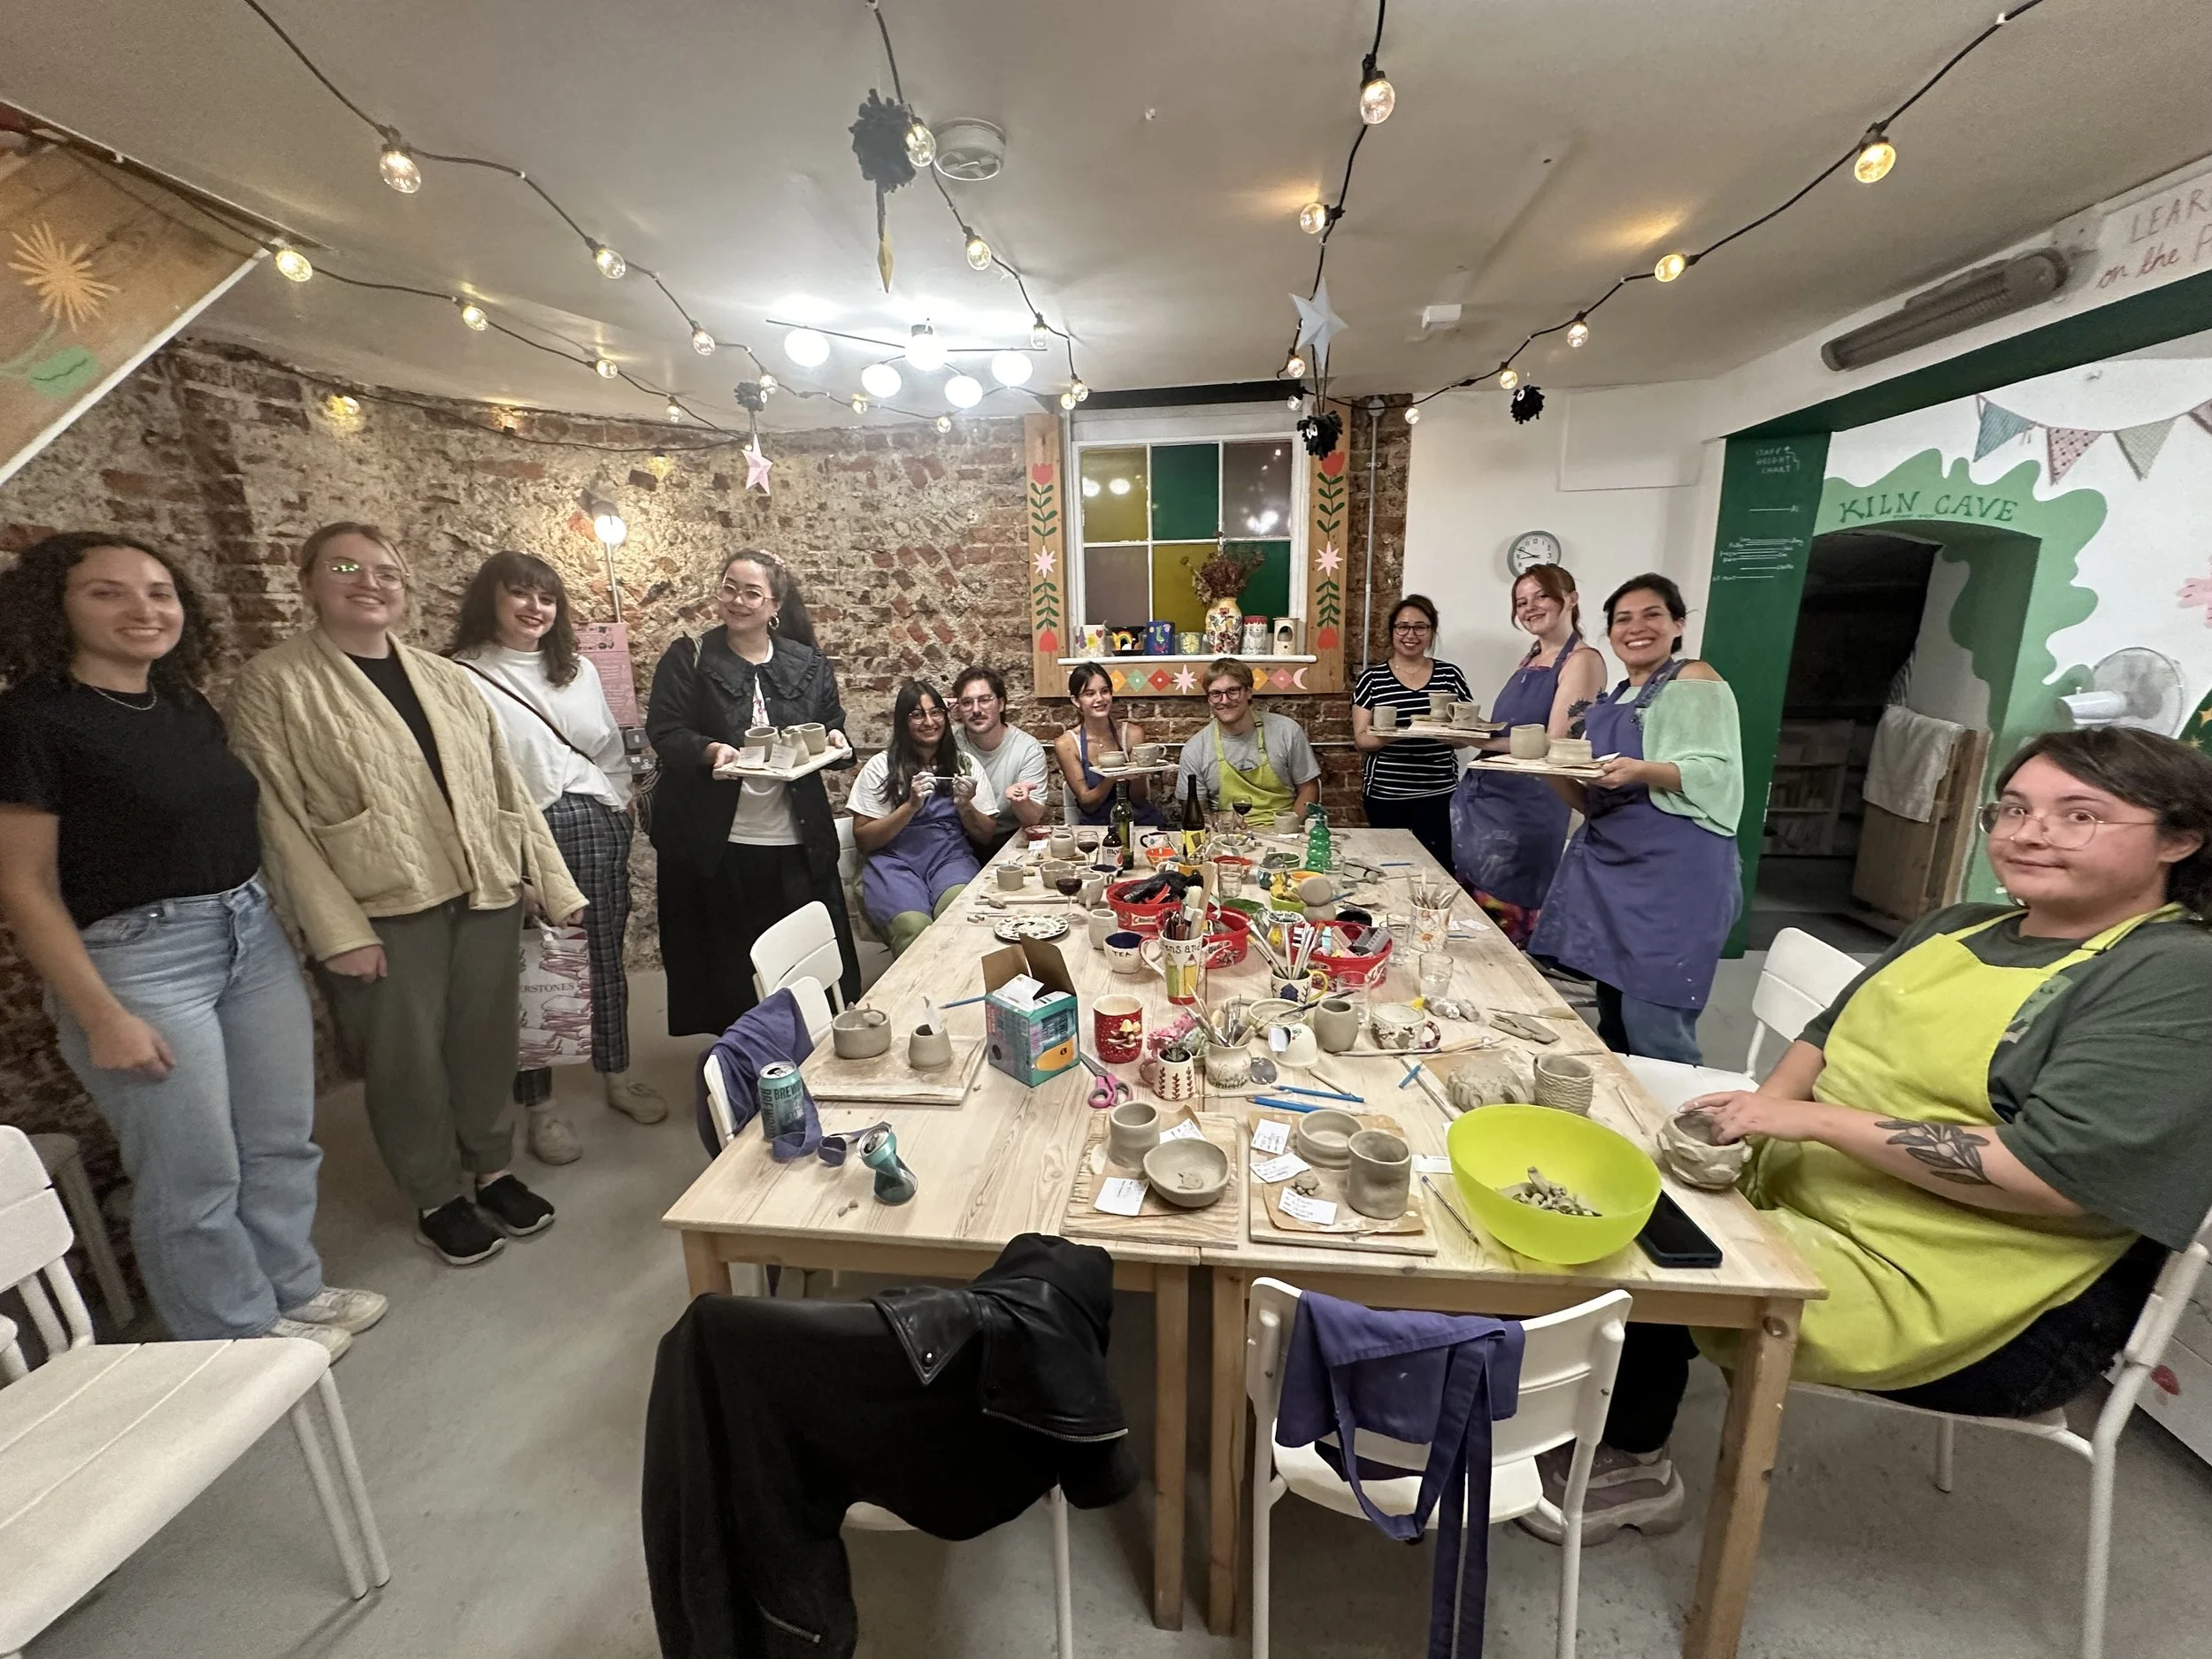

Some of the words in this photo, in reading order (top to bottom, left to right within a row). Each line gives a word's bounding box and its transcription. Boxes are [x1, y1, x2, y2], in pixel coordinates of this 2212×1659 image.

[2130, 188, 2212, 243] LEAR
[2135, 242, 2180, 279] the
[1839, 490, 1921, 523] KILN
[1934, 494, 2018, 522] CAVE
